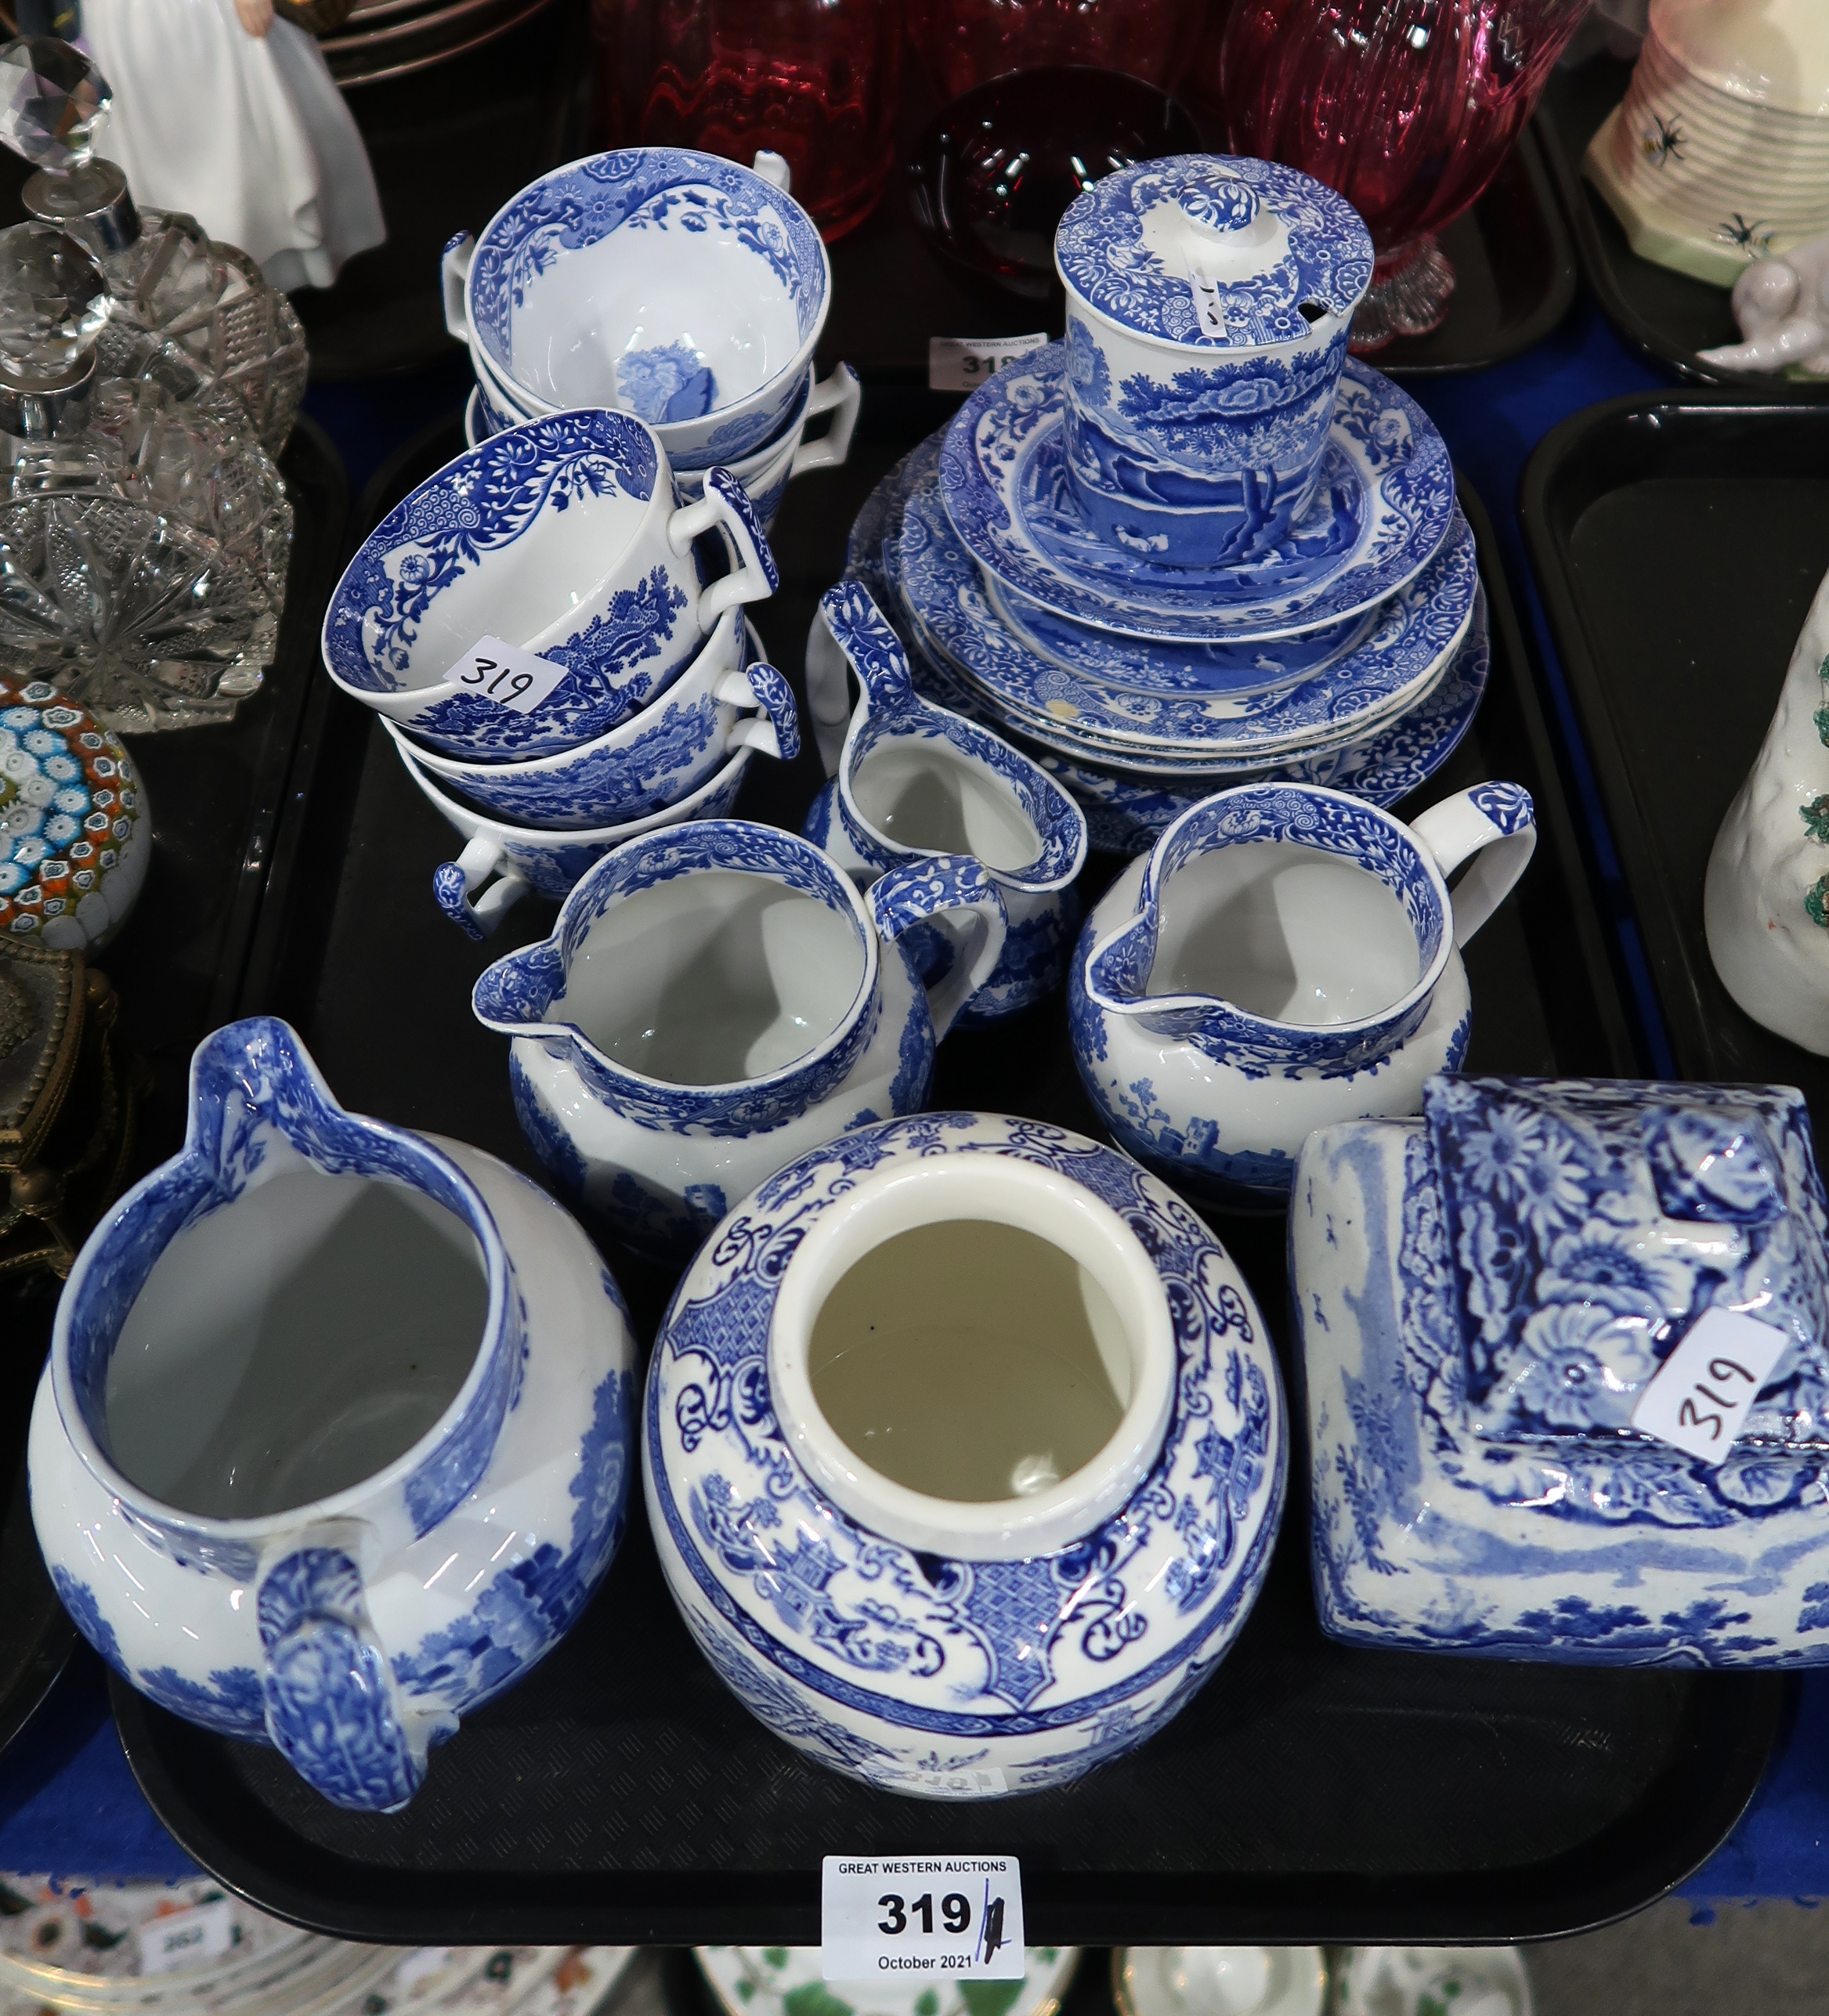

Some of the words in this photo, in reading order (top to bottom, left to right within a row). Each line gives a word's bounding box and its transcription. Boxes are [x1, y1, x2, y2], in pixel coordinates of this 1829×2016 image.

[1003, 337, 1039, 347] AUCTIONS
[461, 657, 533, 704] 319
[1679, 1357, 1755, 1440] 319
[839, 1862, 878, 1874] GREAT
[883, 1862, 941, 1873] WESTERN
[945, 1861, 1007, 1872] AUCTIONS
[877, 1892, 971, 1935] 319
[878, 1956, 935, 1970] October
[940, 1955, 971, 1968] 2021
